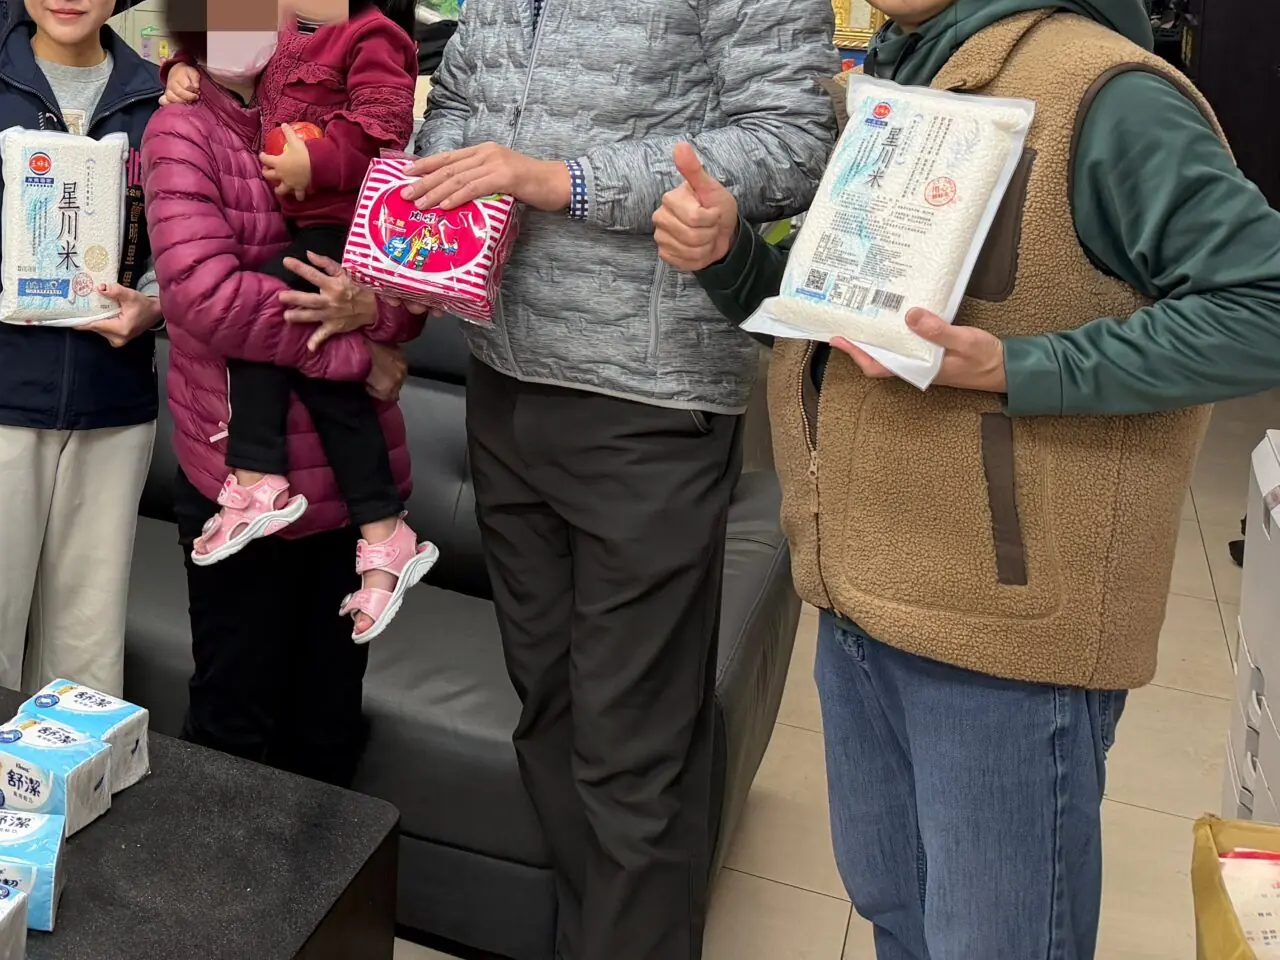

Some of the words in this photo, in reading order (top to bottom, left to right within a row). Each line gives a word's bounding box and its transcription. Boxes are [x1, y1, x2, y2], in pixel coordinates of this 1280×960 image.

[864, 127, 902, 188] 星川米
[56, 182, 80, 271] 星川米
[6, 769, 41, 798] 舒潔
